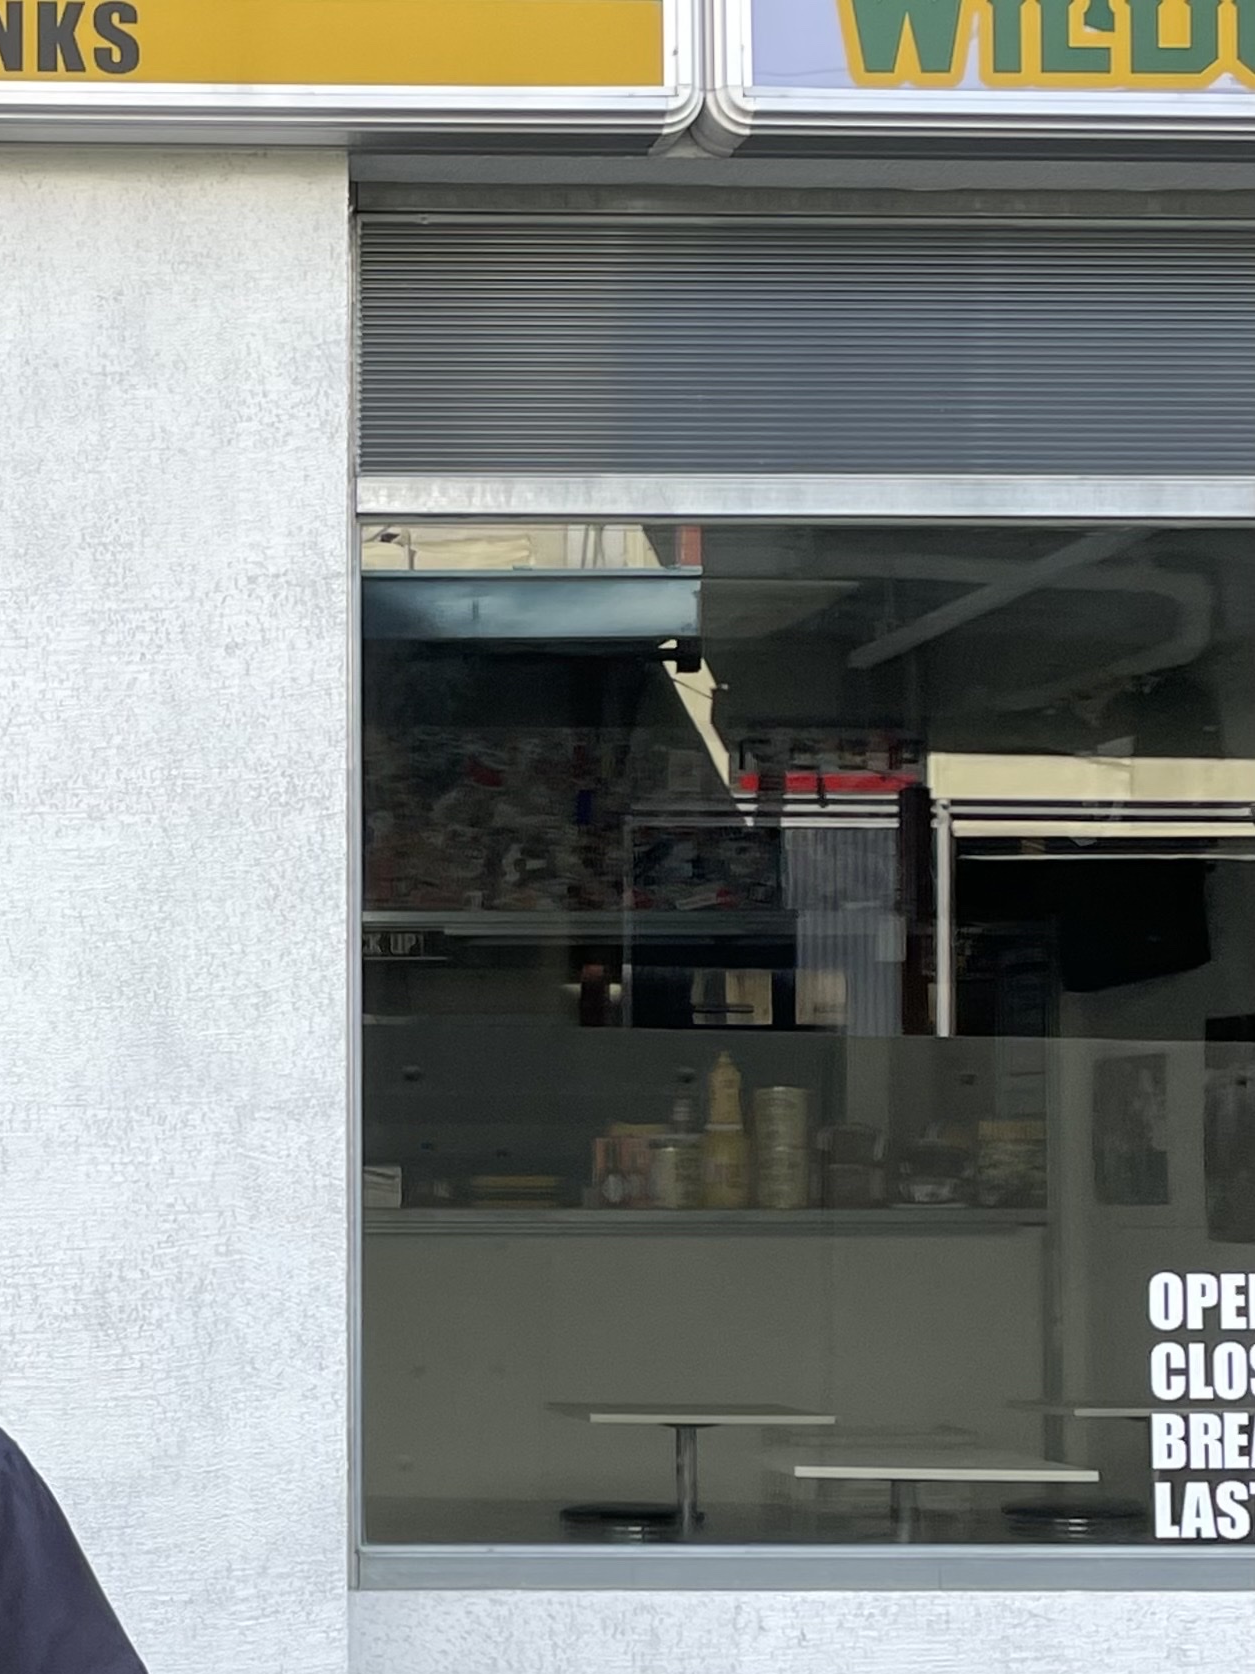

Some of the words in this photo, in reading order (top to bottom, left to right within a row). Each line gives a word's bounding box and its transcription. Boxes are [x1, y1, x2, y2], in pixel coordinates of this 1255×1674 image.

[1149, 1271, 1255, 1331] OPE
[1150, 1341, 1255, 1400] CLO
[1151, 1412, 1255, 1470] BRE
[1154, 1480, 1255, 1540] LAS
